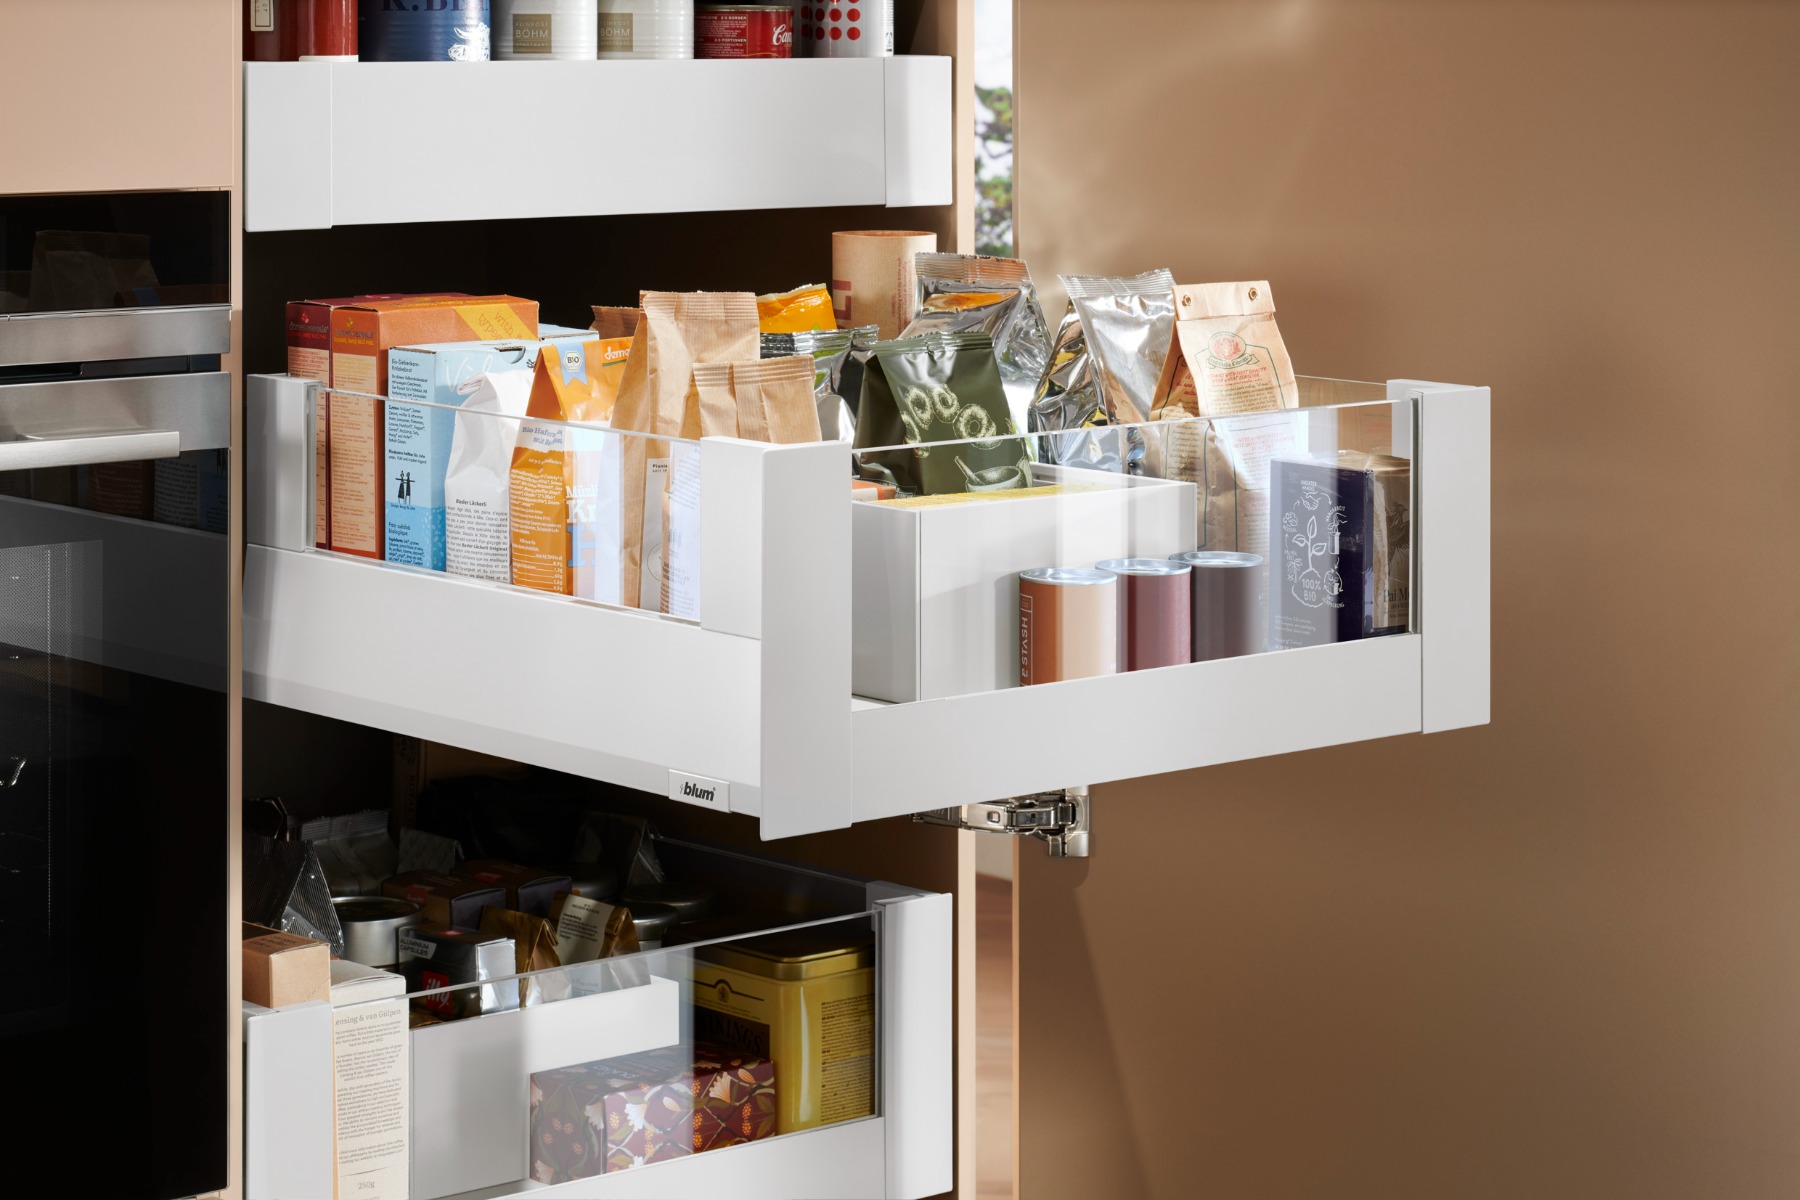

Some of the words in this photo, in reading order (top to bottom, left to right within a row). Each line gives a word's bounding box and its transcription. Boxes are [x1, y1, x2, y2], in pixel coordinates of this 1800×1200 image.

[516, 28, 548, 38] BÖHM
[600, 27, 630, 37] BÖHM
[604, 346, 631, 360] deme
[1302, 578, 1322, 591] 100%
[1304, 590, 1316, 602] BIO
[683, 781, 716, 802] blum
[426, 978, 450, 1008] illy
[358, 1181, 376, 1190] 250g
